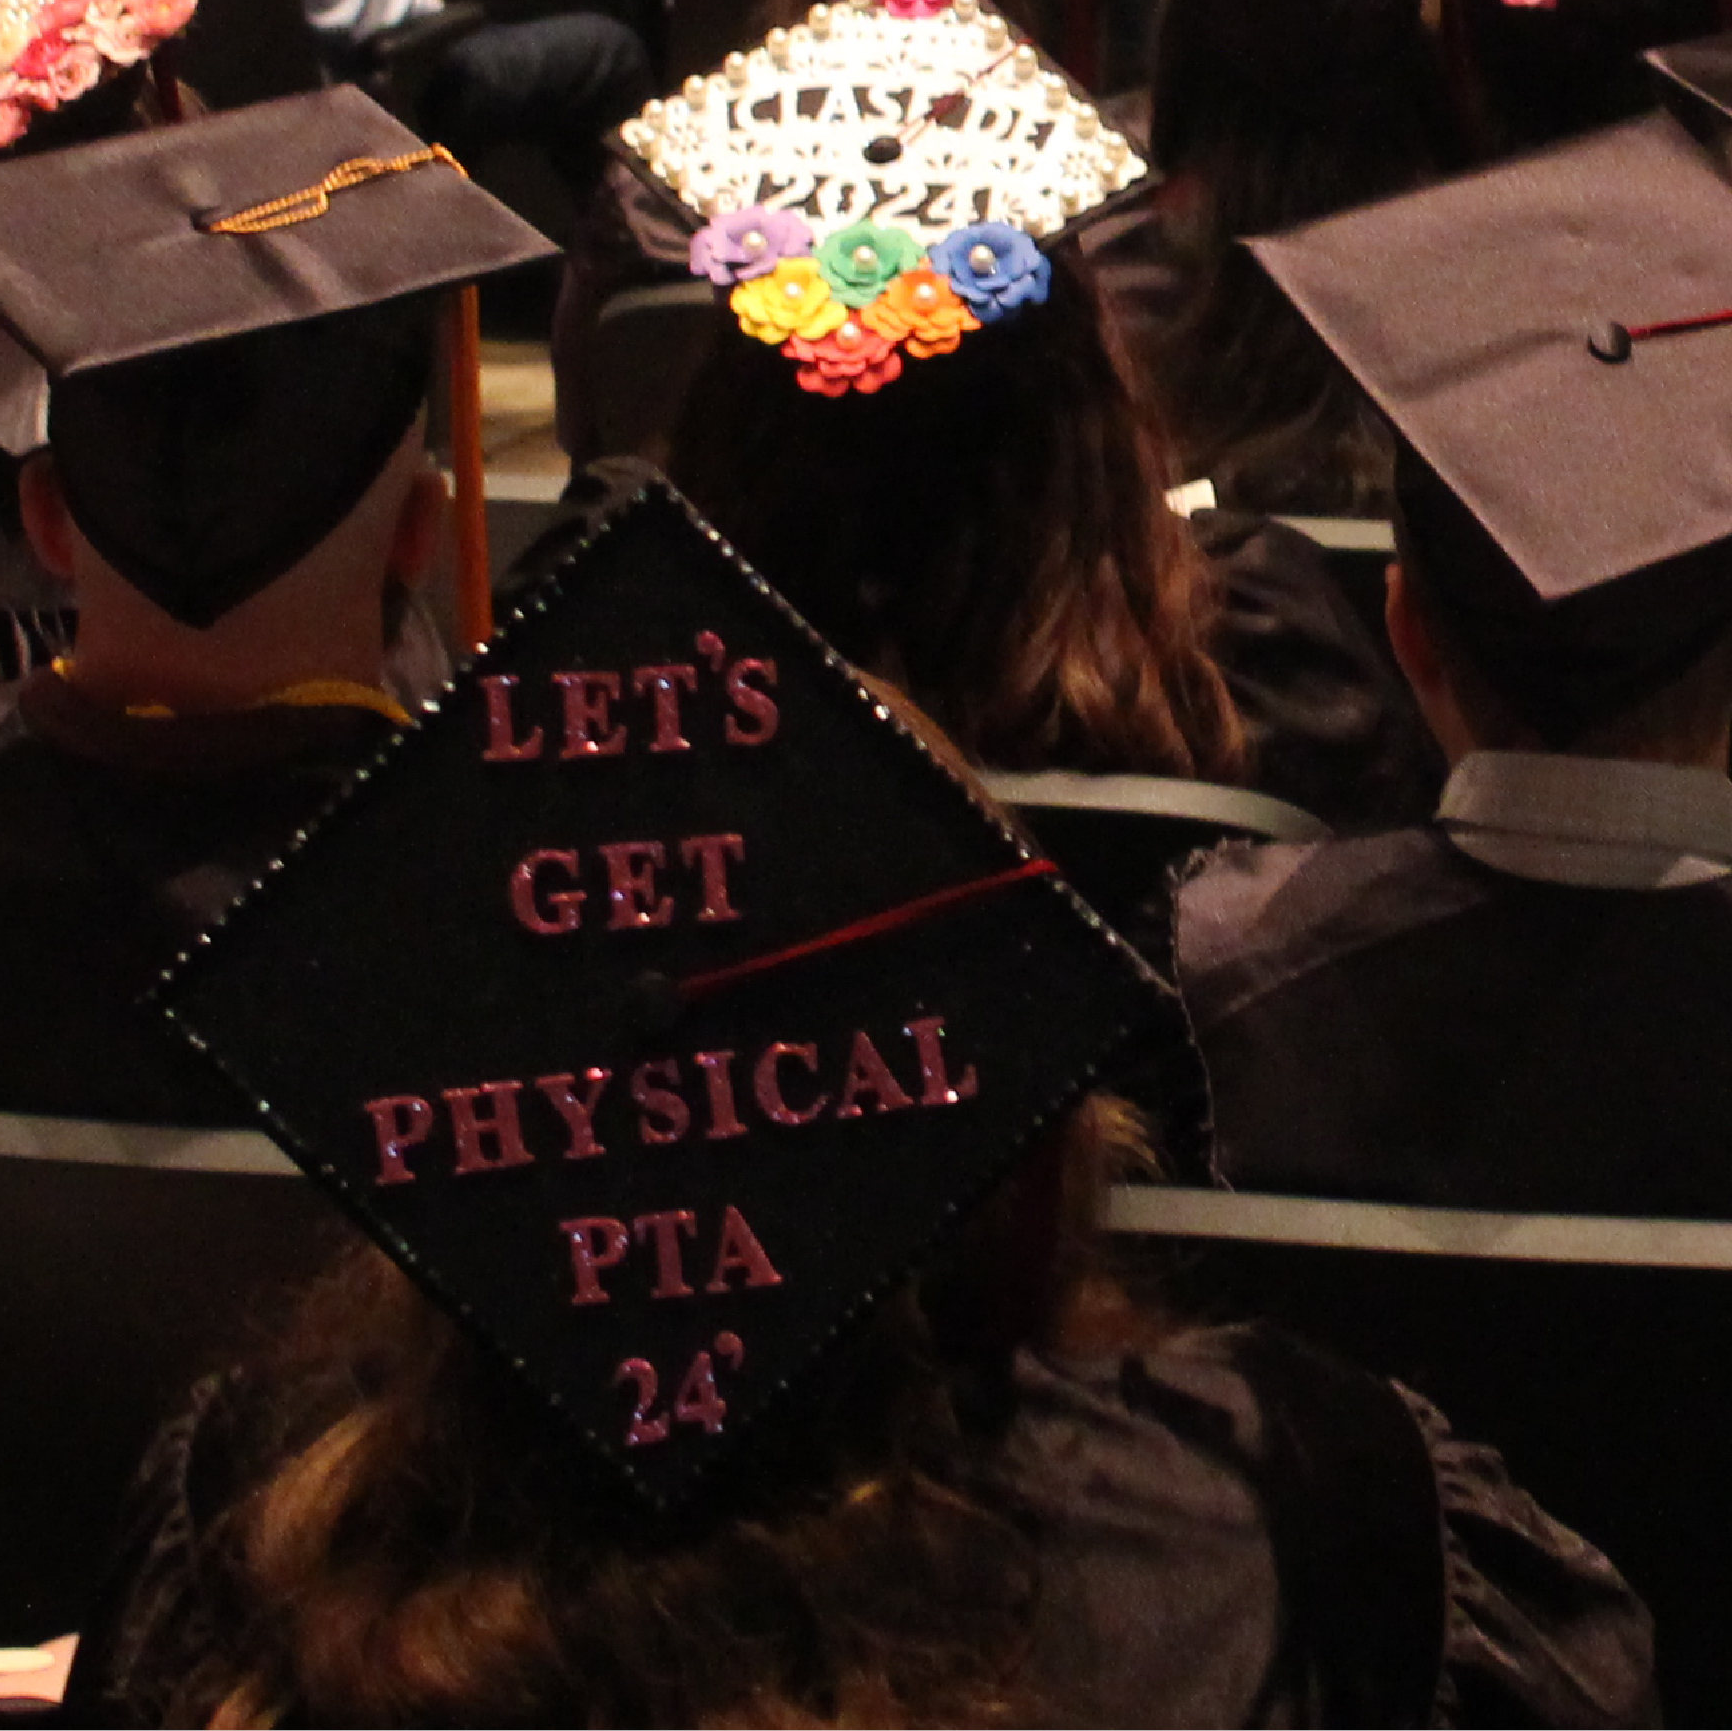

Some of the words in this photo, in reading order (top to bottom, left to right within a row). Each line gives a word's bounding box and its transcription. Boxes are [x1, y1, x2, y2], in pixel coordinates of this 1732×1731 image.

[765, 171, 980, 226] 2024
[481, 629, 781, 765] LET'S
[509, 831, 746, 937] GET
[363, 1015, 980, 1187] PHYSICAL
[559, 1204, 784, 1306] PTA
[613, 1329, 746, 1449] 24'
